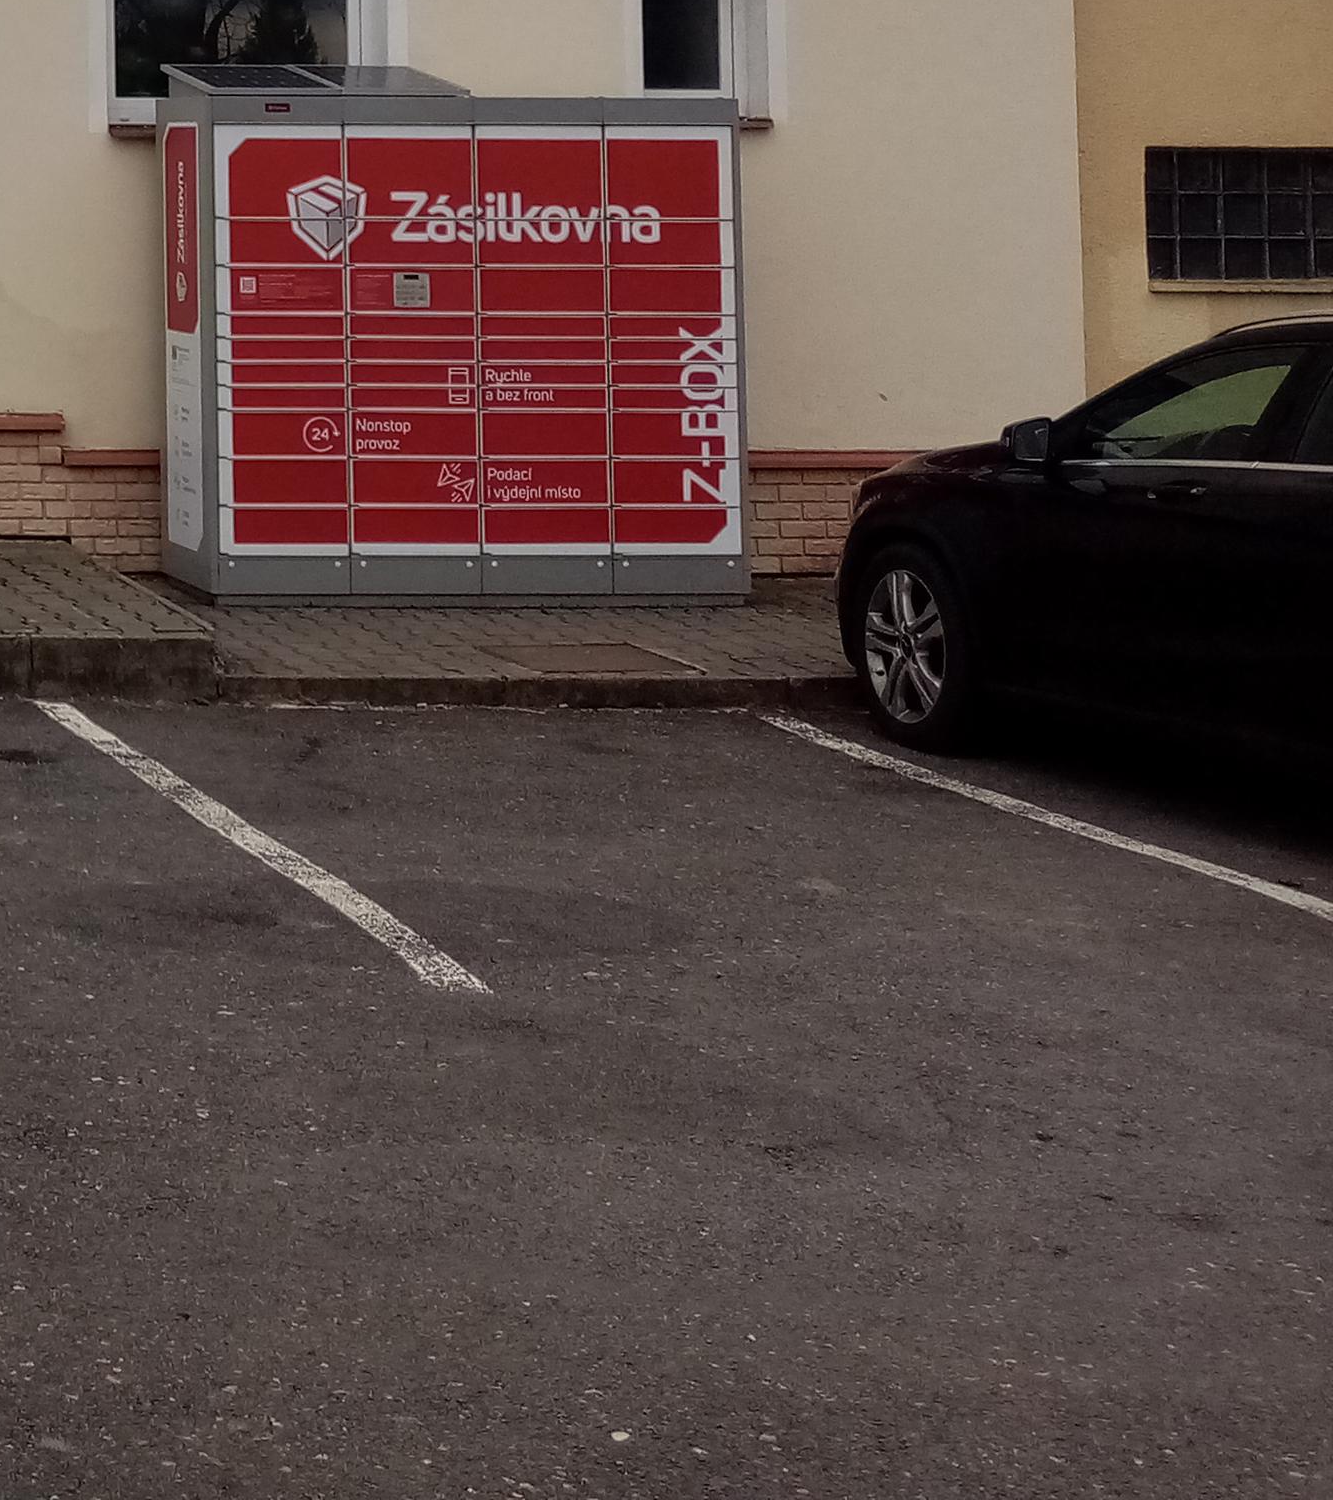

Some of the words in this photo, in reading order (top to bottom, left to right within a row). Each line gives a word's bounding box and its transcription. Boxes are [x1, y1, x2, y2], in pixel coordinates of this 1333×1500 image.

[389, 191, 661, 244] Zásilkovna
[485, 368, 532, 385] Rychle
[485, 390, 494, 402] a
[496, 389, 520, 402] bez
[523, 388, 555, 402] front
[679, 326, 727, 503] Z-BOX
[355, 417, 411, 435] Nonstop
[311, 428, 330, 441] 24
[355, 438, 400, 452] provoz
[487, 467, 532, 482] Podací
[494, 486, 542, 501] výdejní
[546, 486, 581, 499] místo
